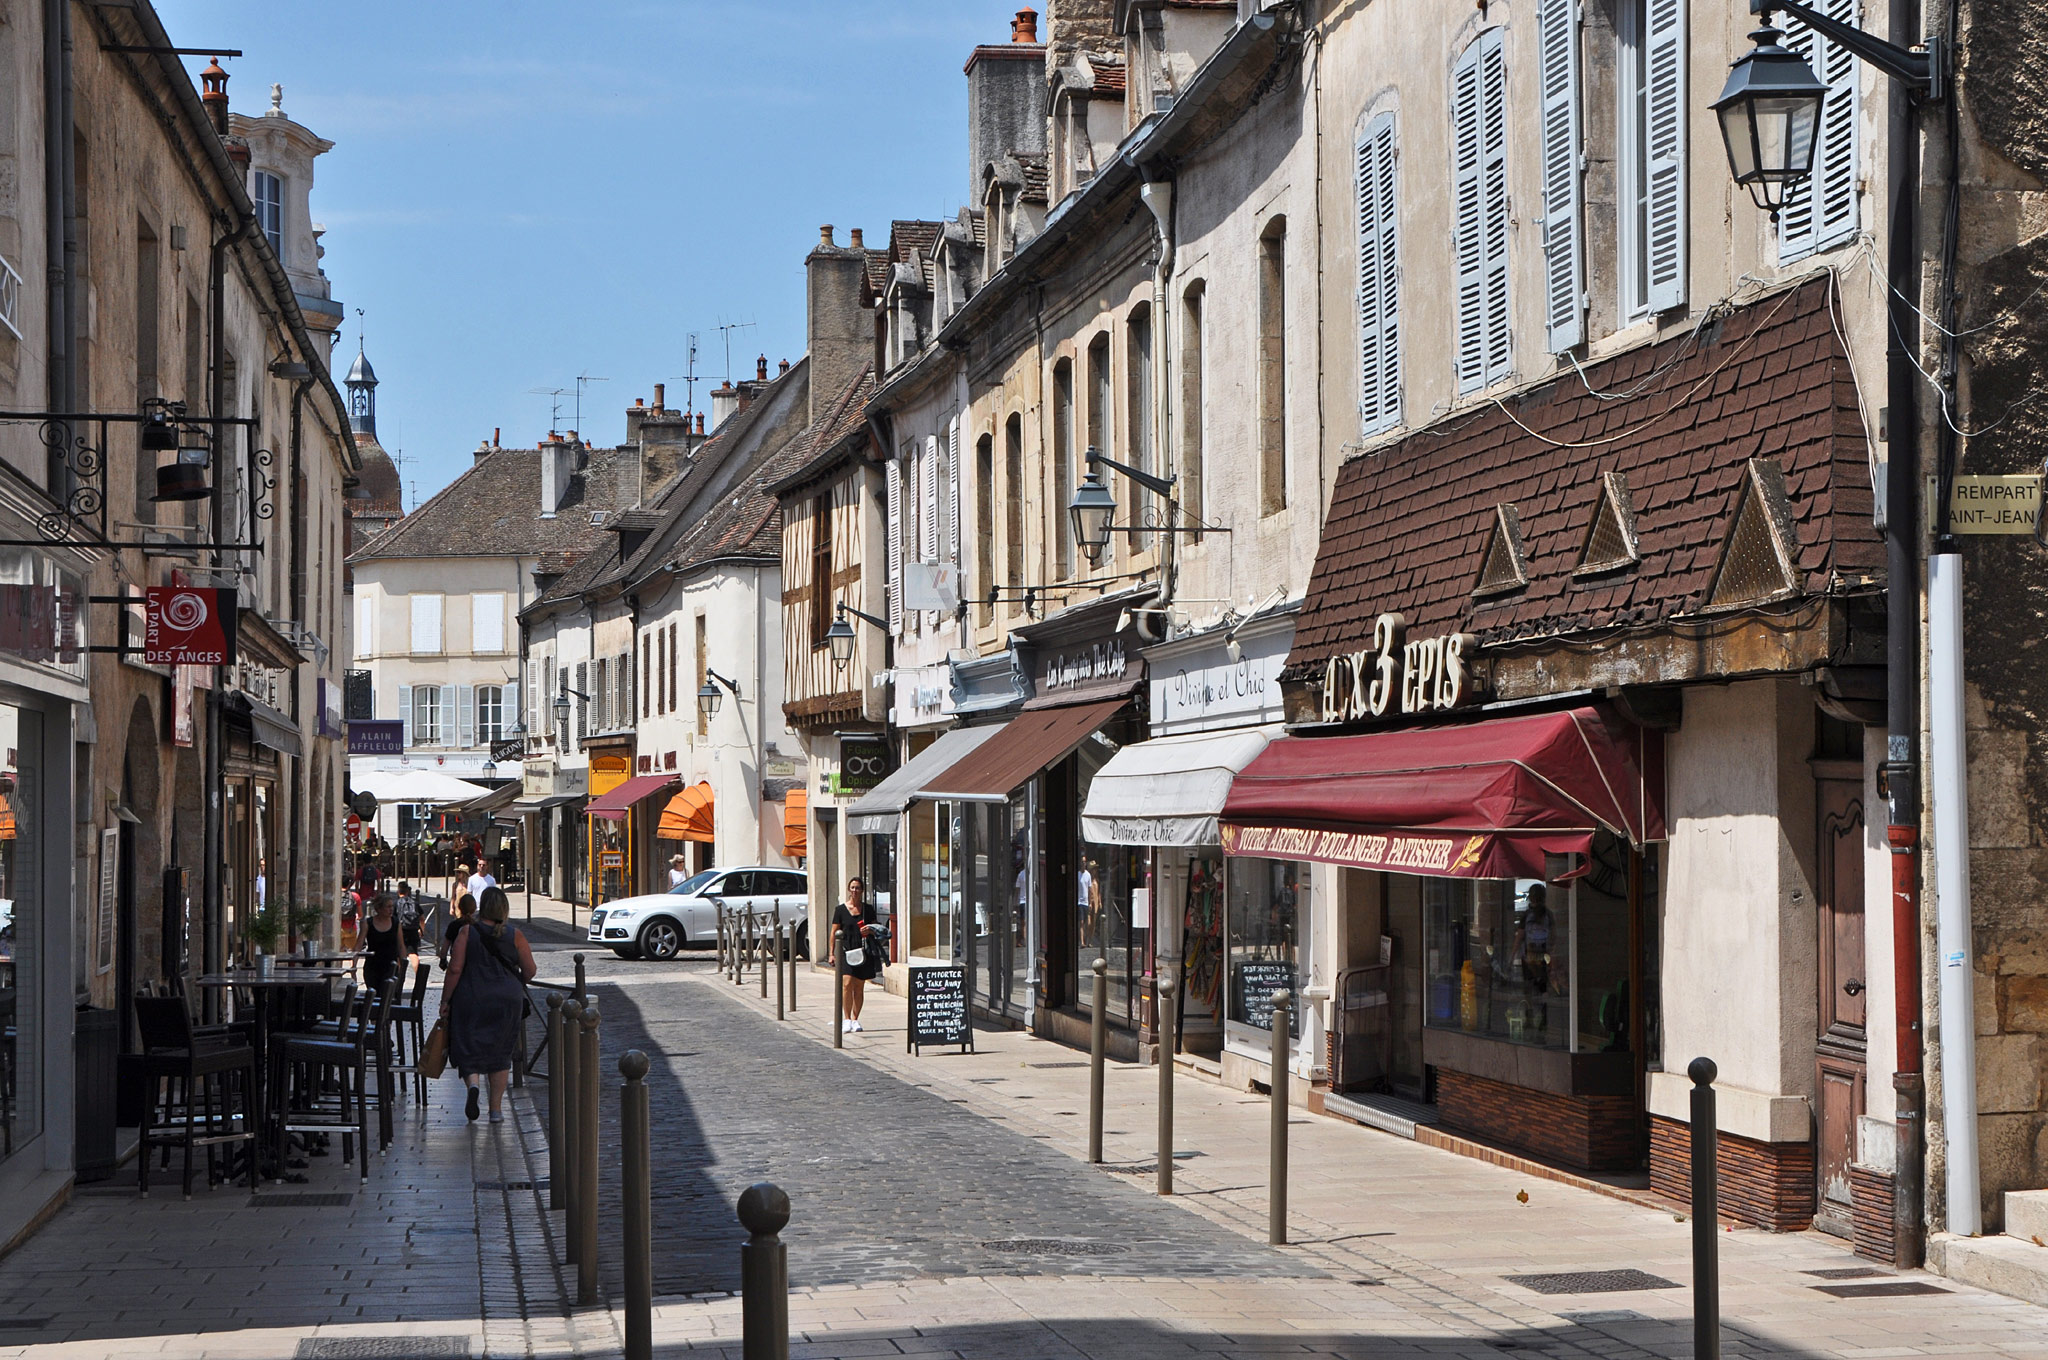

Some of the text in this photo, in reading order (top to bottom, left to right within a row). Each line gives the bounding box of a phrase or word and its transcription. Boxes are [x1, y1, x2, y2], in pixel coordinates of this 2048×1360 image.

[1957, 485, 2036, 500] REMPART
[1949, 510, 2035, 524] AINT-JEAN
[147, 592, 159, 645] LA PART
[146, 650, 222, 663] DES ANGES
[1322, 612, 1468, 723] AUX 3 EPIS
[1175, 668, 1215, 707] Divine
[1235, 654, 1265, 697] Chic
[350, 742, 401, 751] AFFLELOU
[361, 732, 391, 740] ALAIN
[491, 740, 524, 761] GUIGONE
[1109, 818, 1174, 842] Divine et Chic
[1238, 827, 1453, 870] VOTRE ARTISAN BOULANGER PATISSIER
